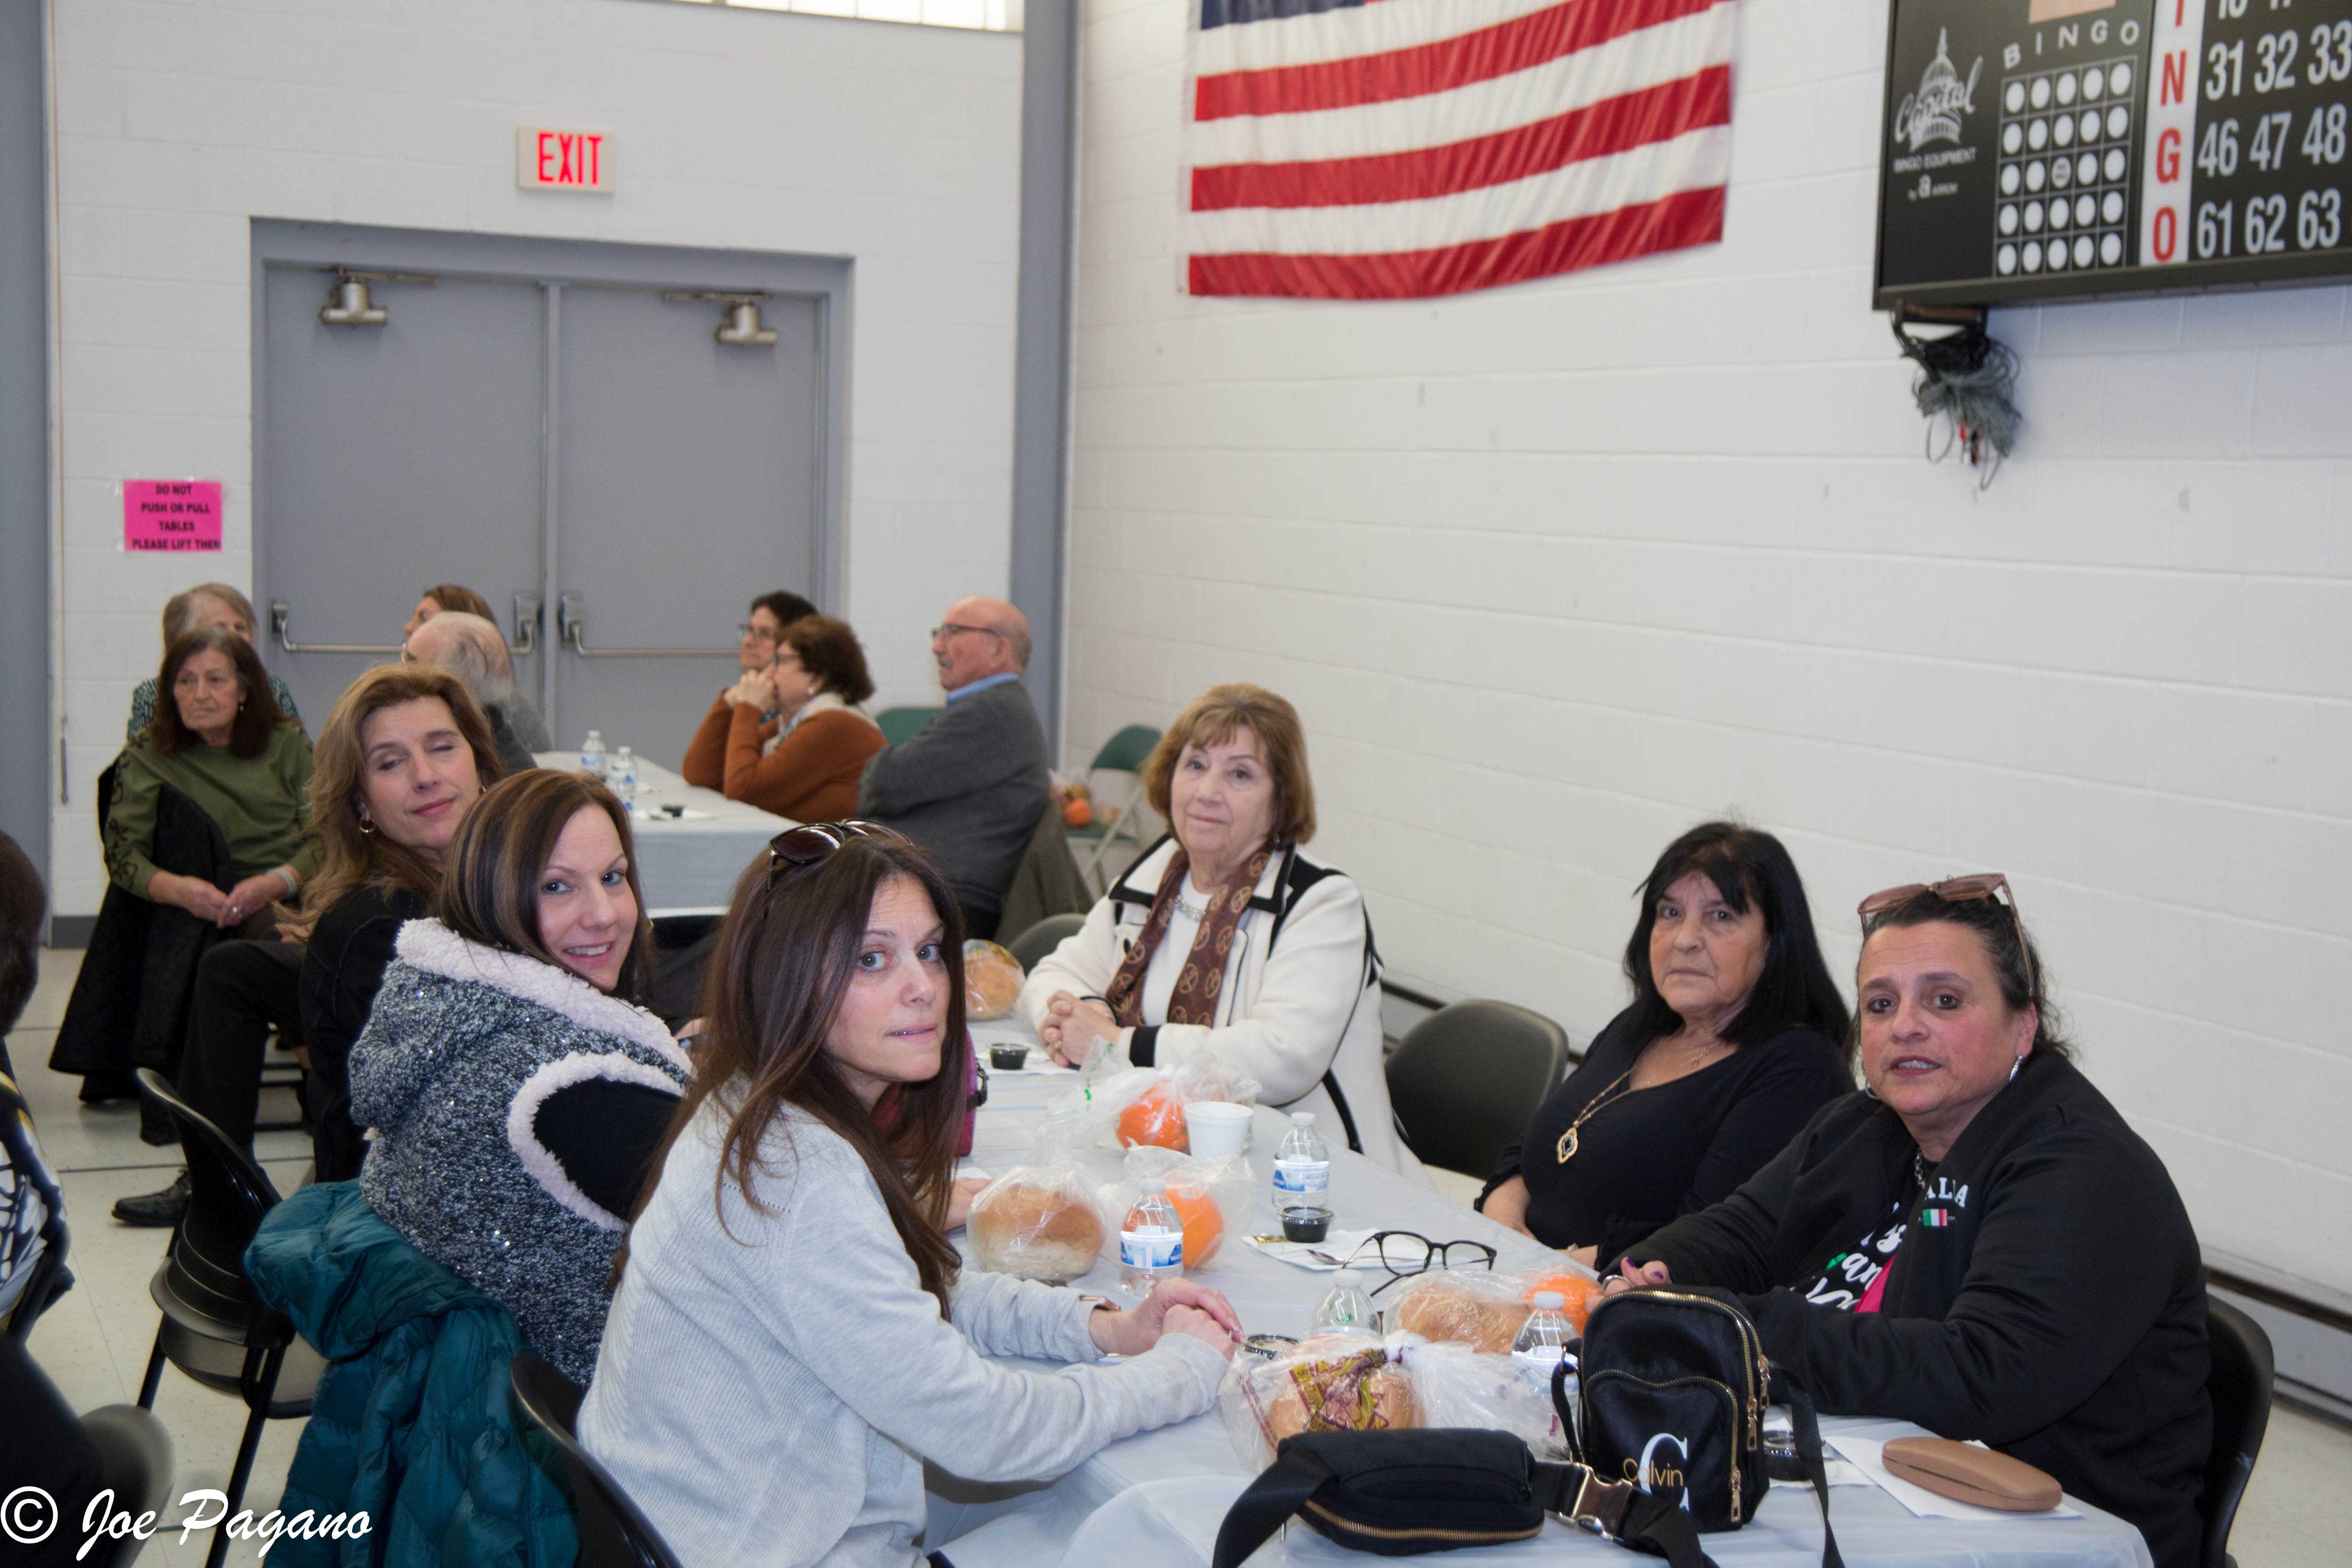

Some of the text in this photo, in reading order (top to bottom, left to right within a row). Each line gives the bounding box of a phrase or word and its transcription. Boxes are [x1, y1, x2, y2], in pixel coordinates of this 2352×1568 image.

[2004, 19, 2139, 69] BINGO
[2160, 19, 2352, 106] N 31 32 33
[538, 131, 603, 186] EXIT
[2156, 103, 2347, 184] G 46 47 48
[2152, 188, 2341, 262] O 61 62 63
[141, 502, 210, 514] PUSH OR PULL
[156, 484, 192, 495] DO NOT
[132, 539, 168, 550] PLEASE
[171, 539, 192, 550] LIFT
[159, 520, 195, 531] TABLES
[1624, 1458, 1683, 1487] Calvin
